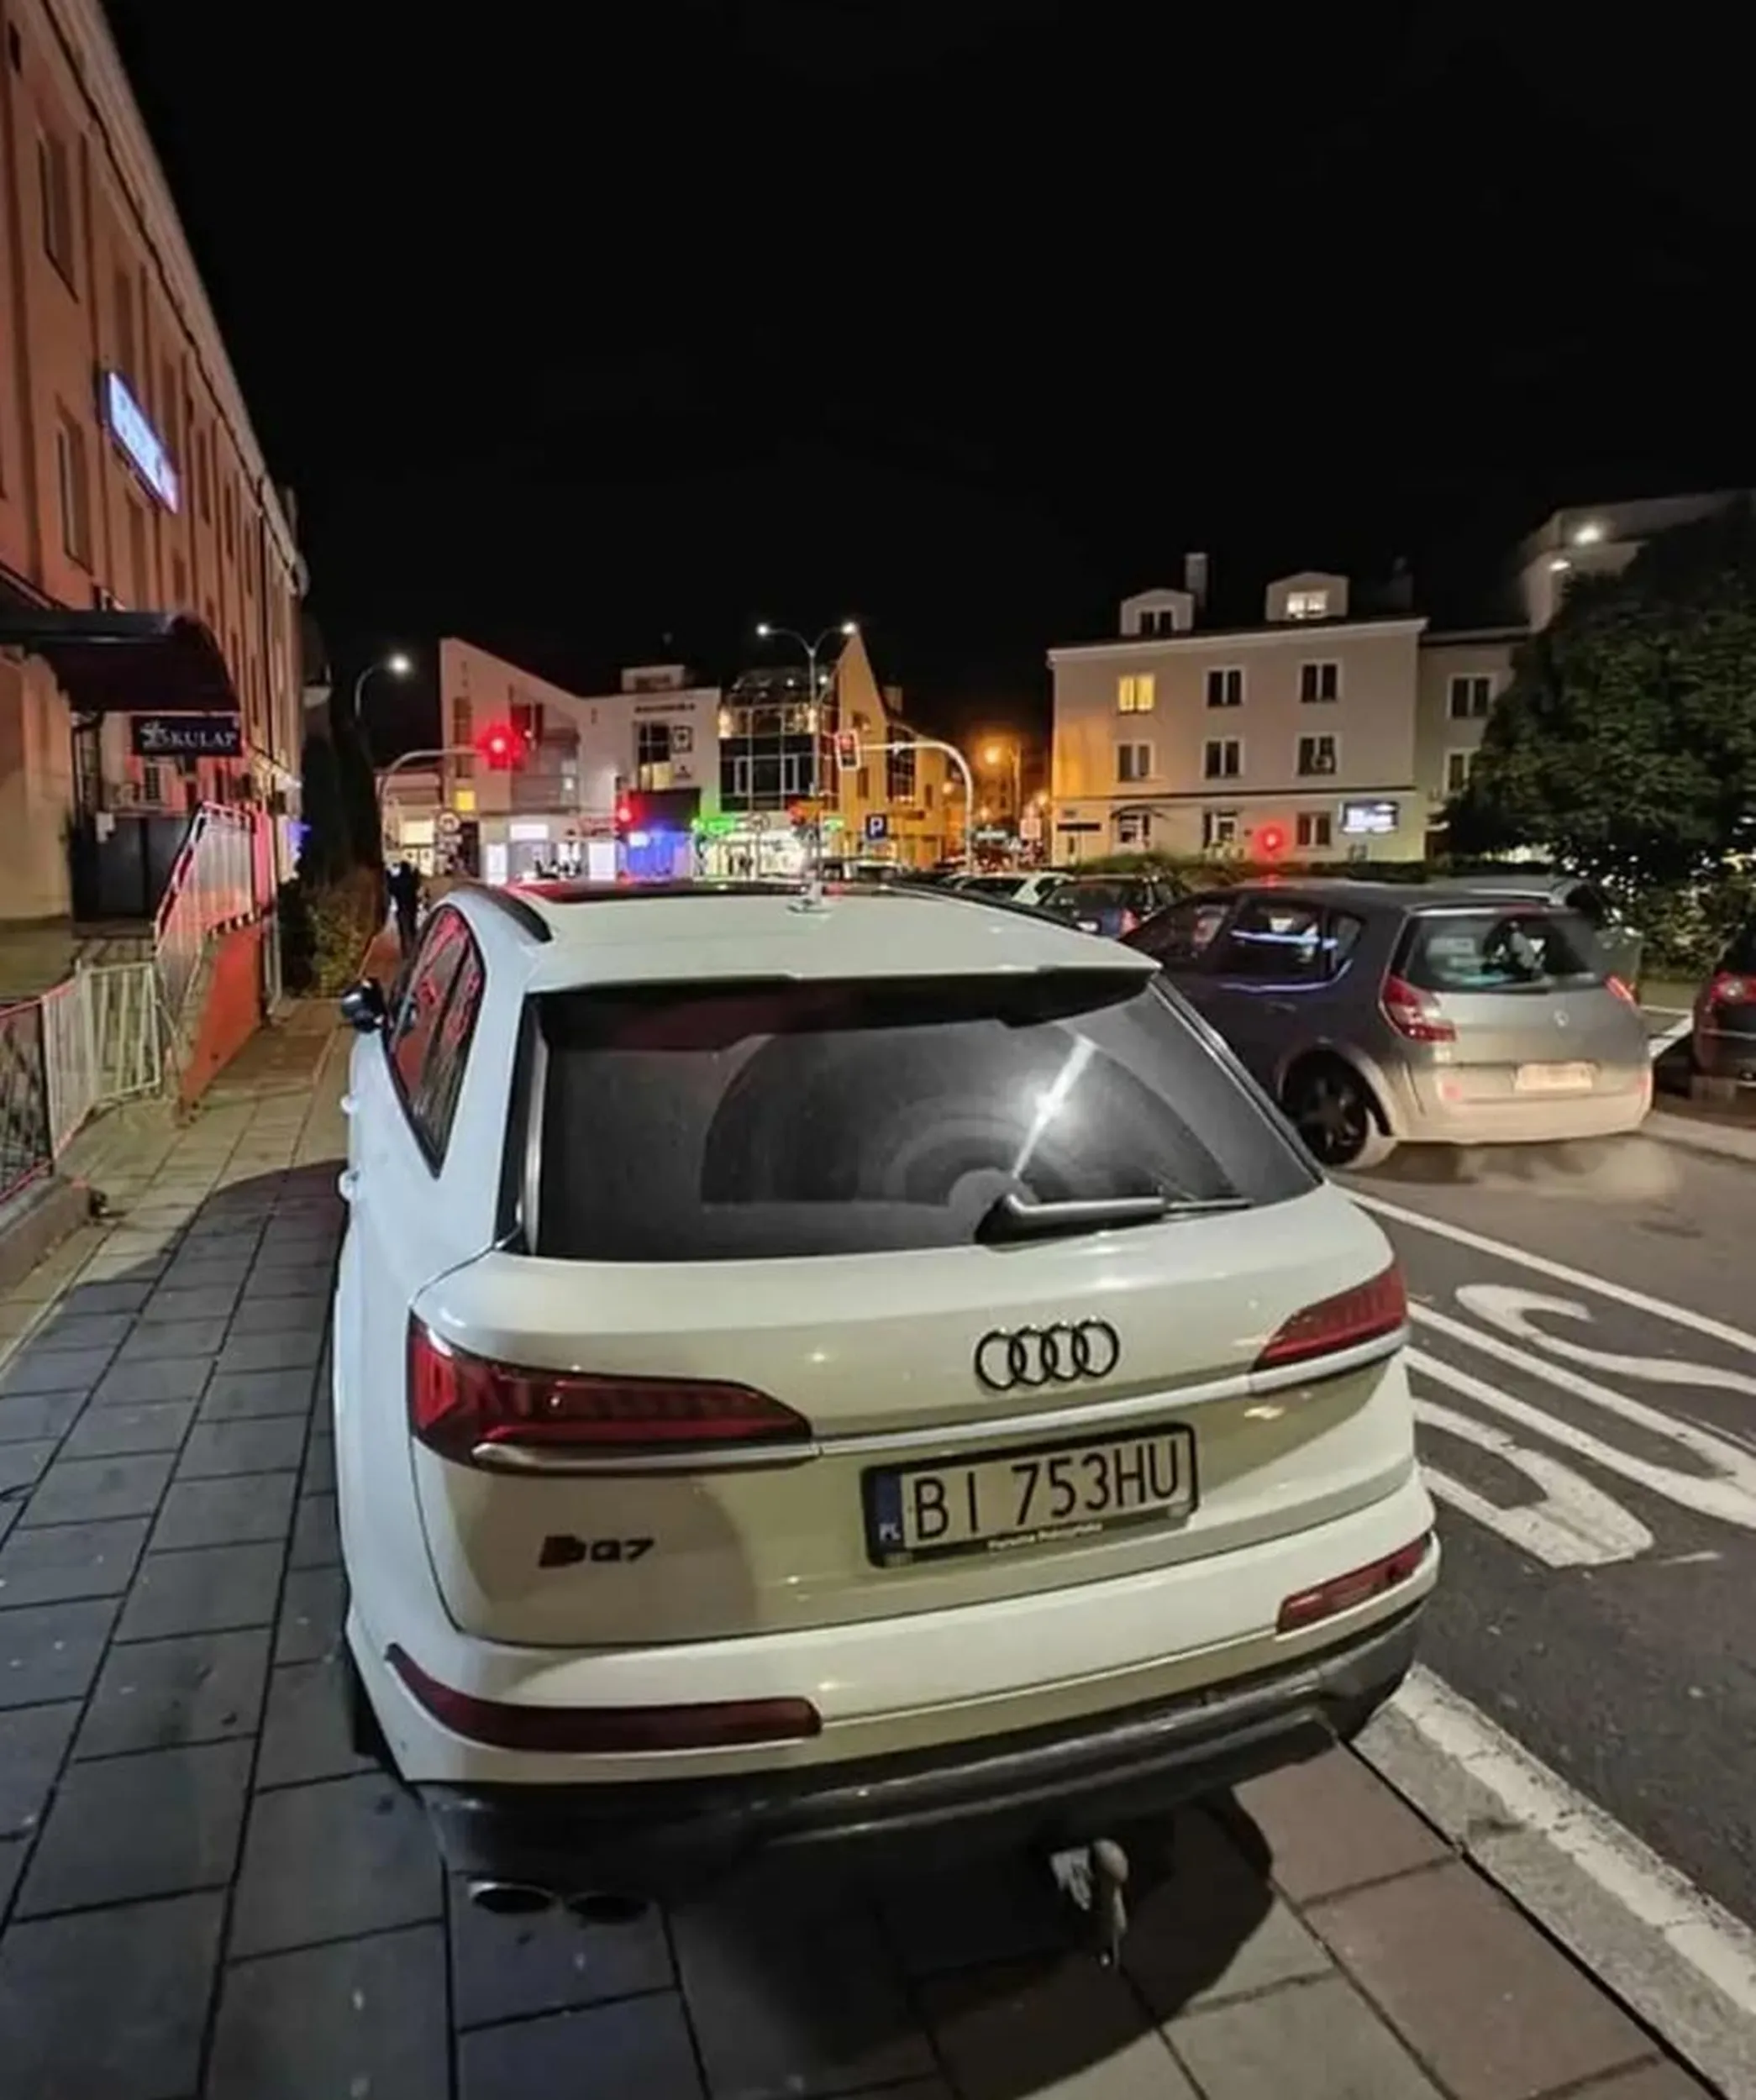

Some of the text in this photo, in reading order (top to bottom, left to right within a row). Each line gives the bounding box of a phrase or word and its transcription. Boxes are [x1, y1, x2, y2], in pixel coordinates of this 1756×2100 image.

[870, 816, 884, 837] P
[913, 1437, 1177, 1541] BI 753HU
